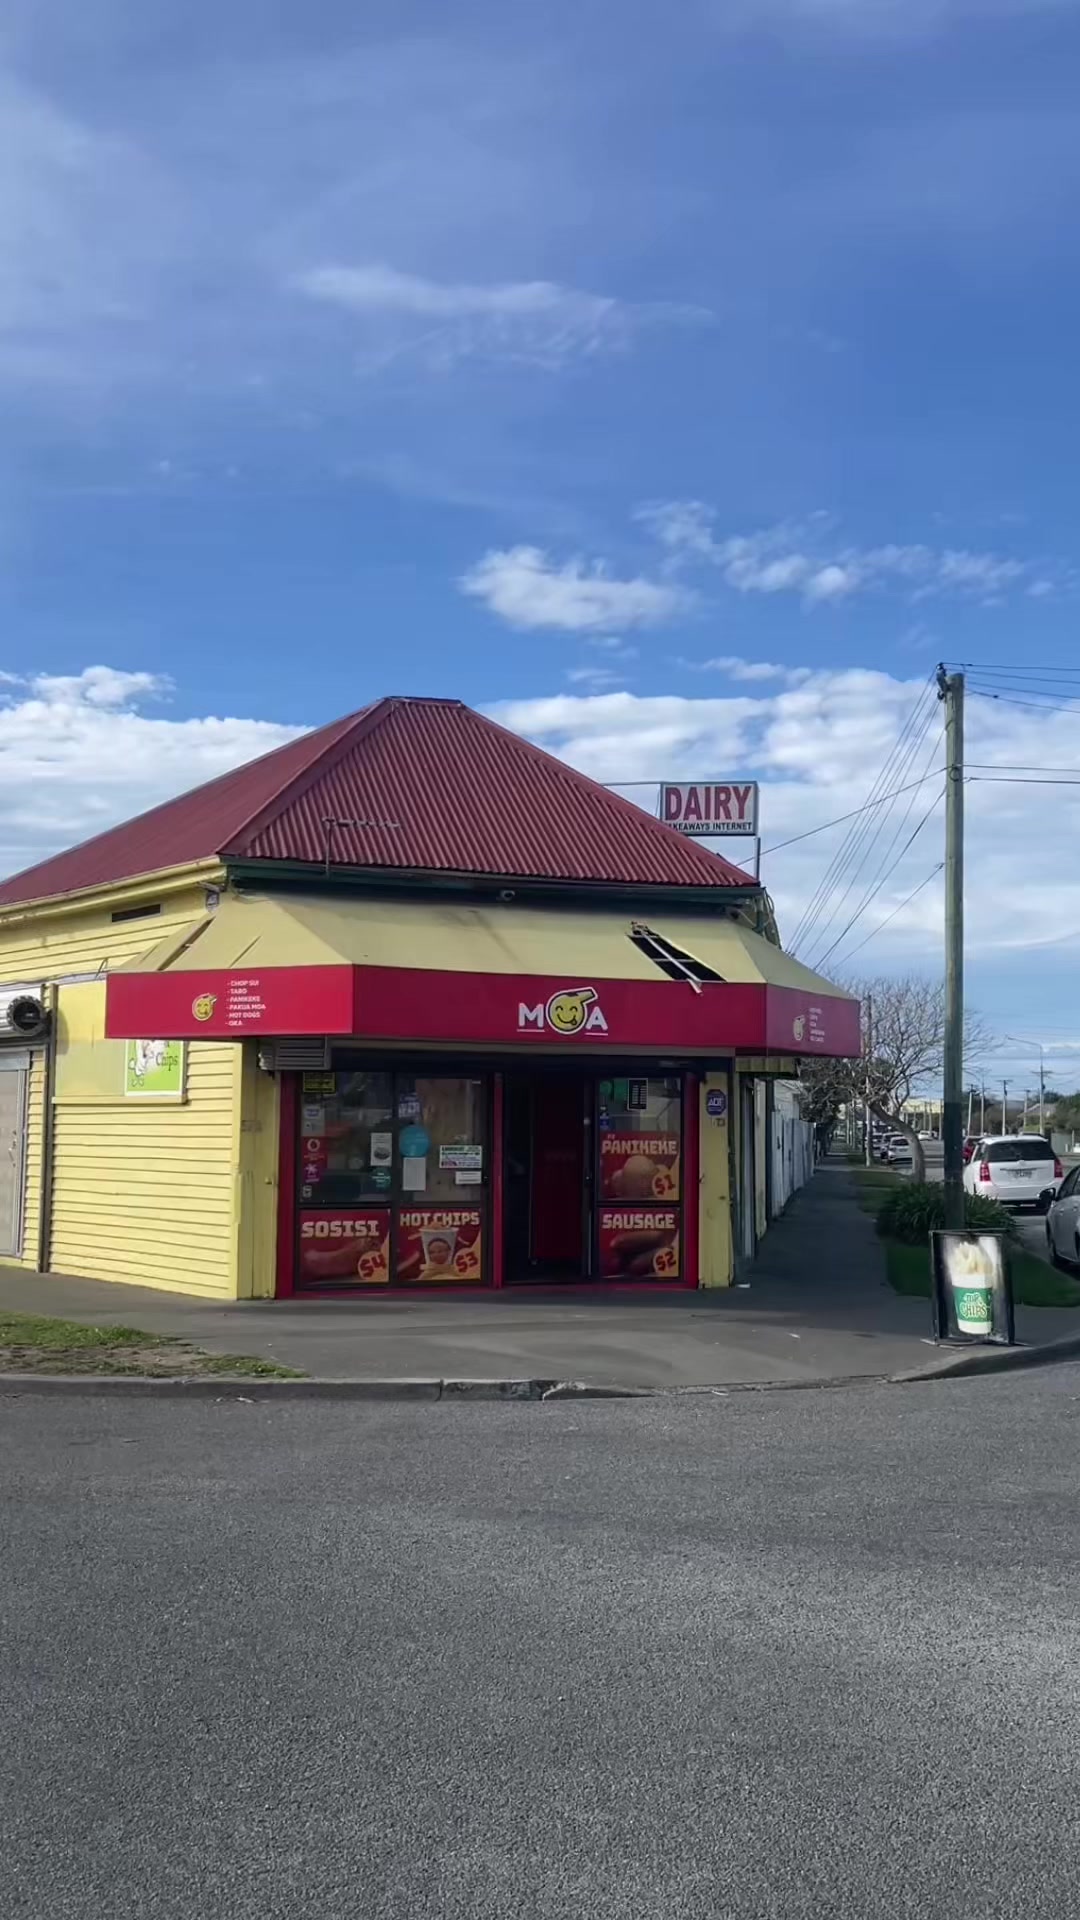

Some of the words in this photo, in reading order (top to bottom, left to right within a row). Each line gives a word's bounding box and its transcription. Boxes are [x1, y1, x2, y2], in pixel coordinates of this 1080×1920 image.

[665, 786, 752, 821] DAIRY
[713, 822, 752, 831] INTERNET
[518, 986, 608, 1035] MOA
[156, 1052, 178, 1071] Chips
[654, 1174, 675, 1195] $1
[301, 1220, 379, 1238] SOSISI
[400, 1213, 430, 1226] HOT
[432, 1212, 480, 1226] CHIPS
[602, 1213, 675, 1229] SAUSAGE
[360, 1252, 386, 1278] $4
[455, 1251, 479, 1273] $3
[656, 1251, 676, 1271] $2
